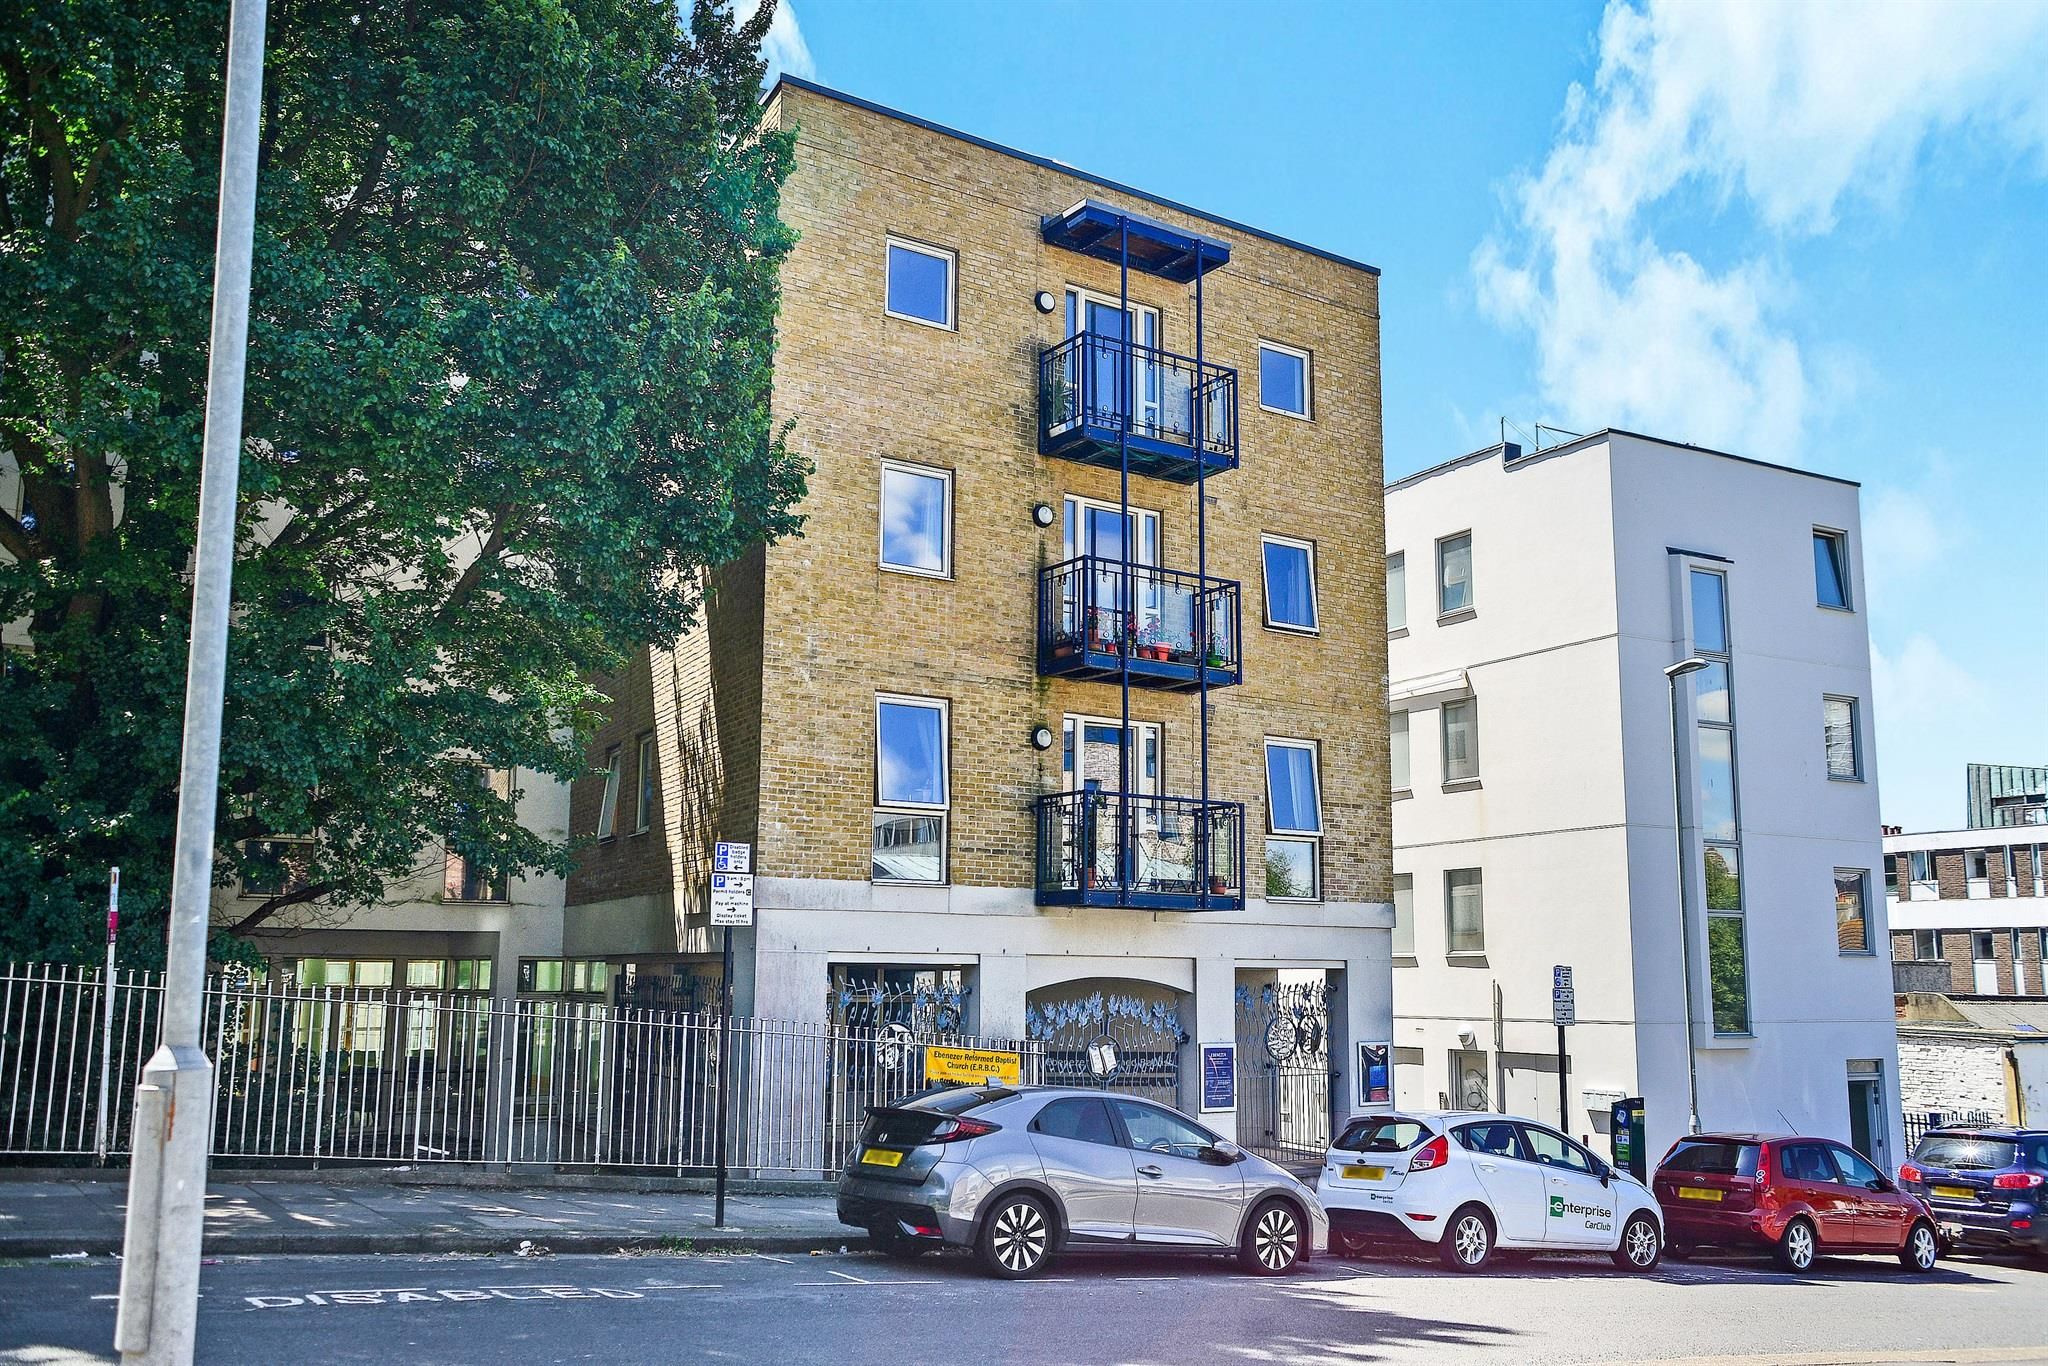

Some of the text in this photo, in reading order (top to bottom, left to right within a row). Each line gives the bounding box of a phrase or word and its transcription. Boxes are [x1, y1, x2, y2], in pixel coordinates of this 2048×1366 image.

[933, 1050, 1017, 1064] Ebenezer Reformed Baptist
[946, 1061, 1000, 1073] Church (E.R.B.C.)
[1585, 1221, 1611, 1231] CarClub
[244, 1287, 645, 1311] DISABLED
